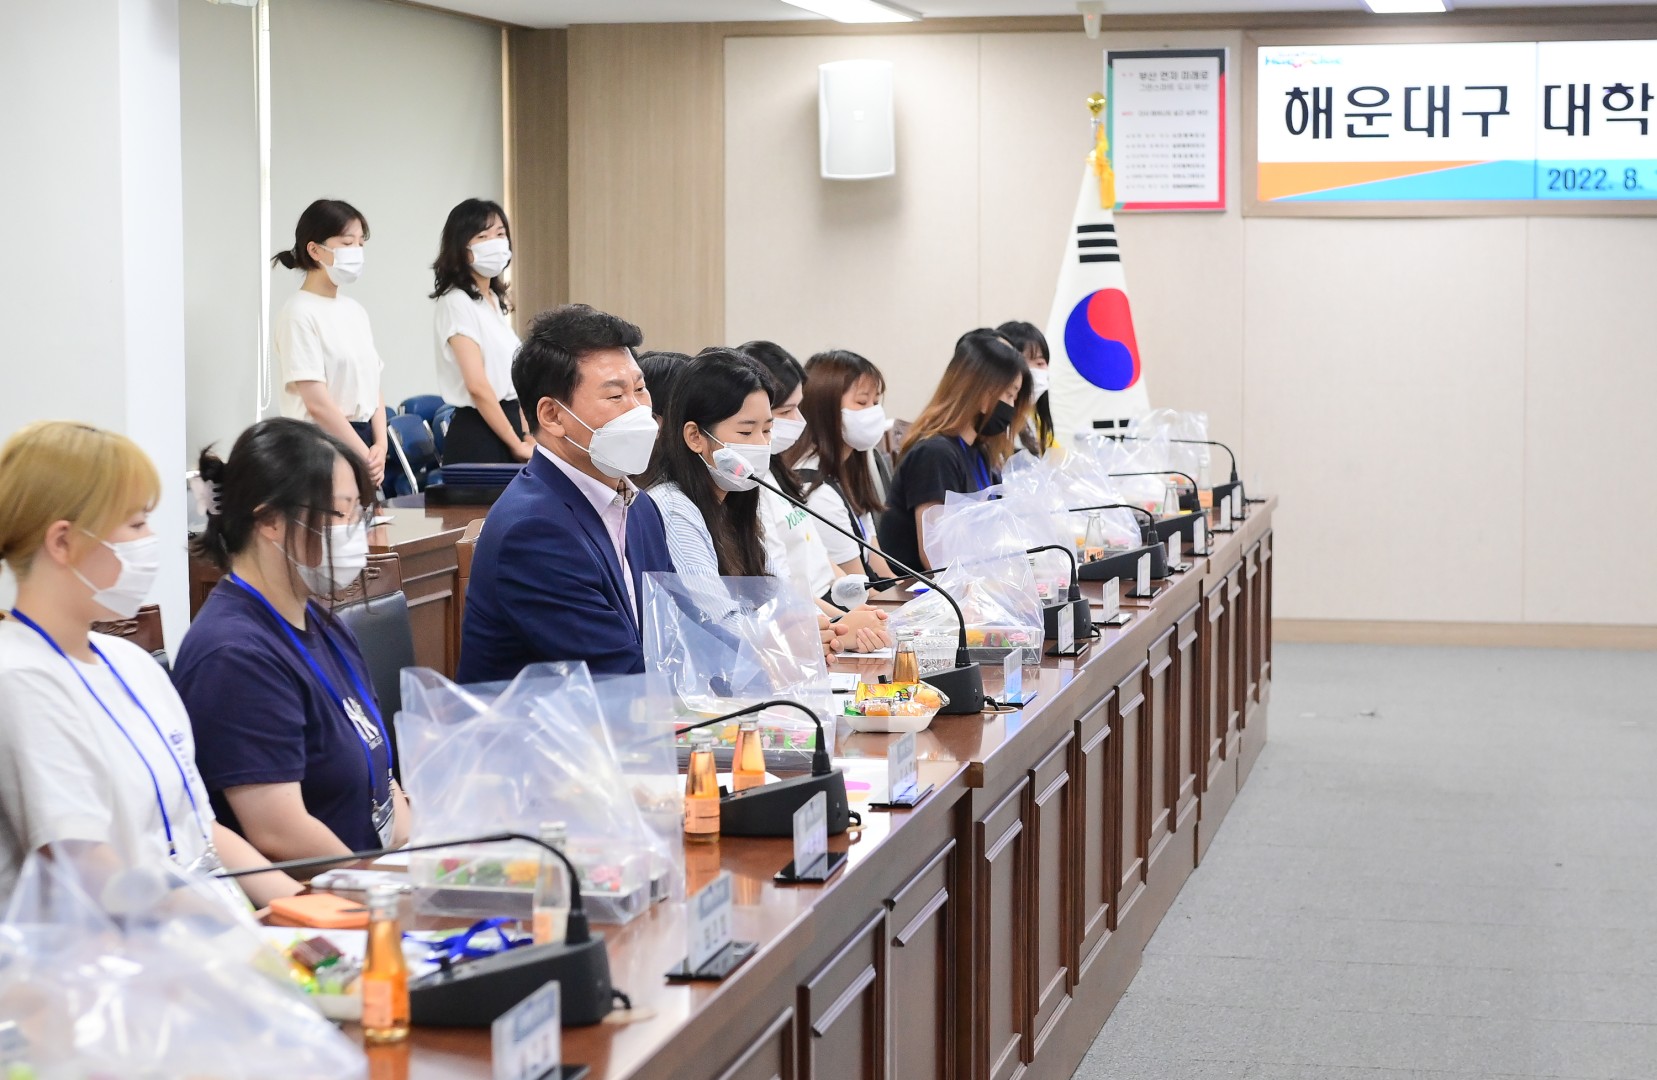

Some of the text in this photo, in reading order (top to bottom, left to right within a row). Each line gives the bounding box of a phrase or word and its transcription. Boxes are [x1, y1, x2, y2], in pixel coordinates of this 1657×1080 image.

[1284, 82, 1656, 139] 해운대구 대학
[1548, 168, 1643, 190] 2022. 8.
